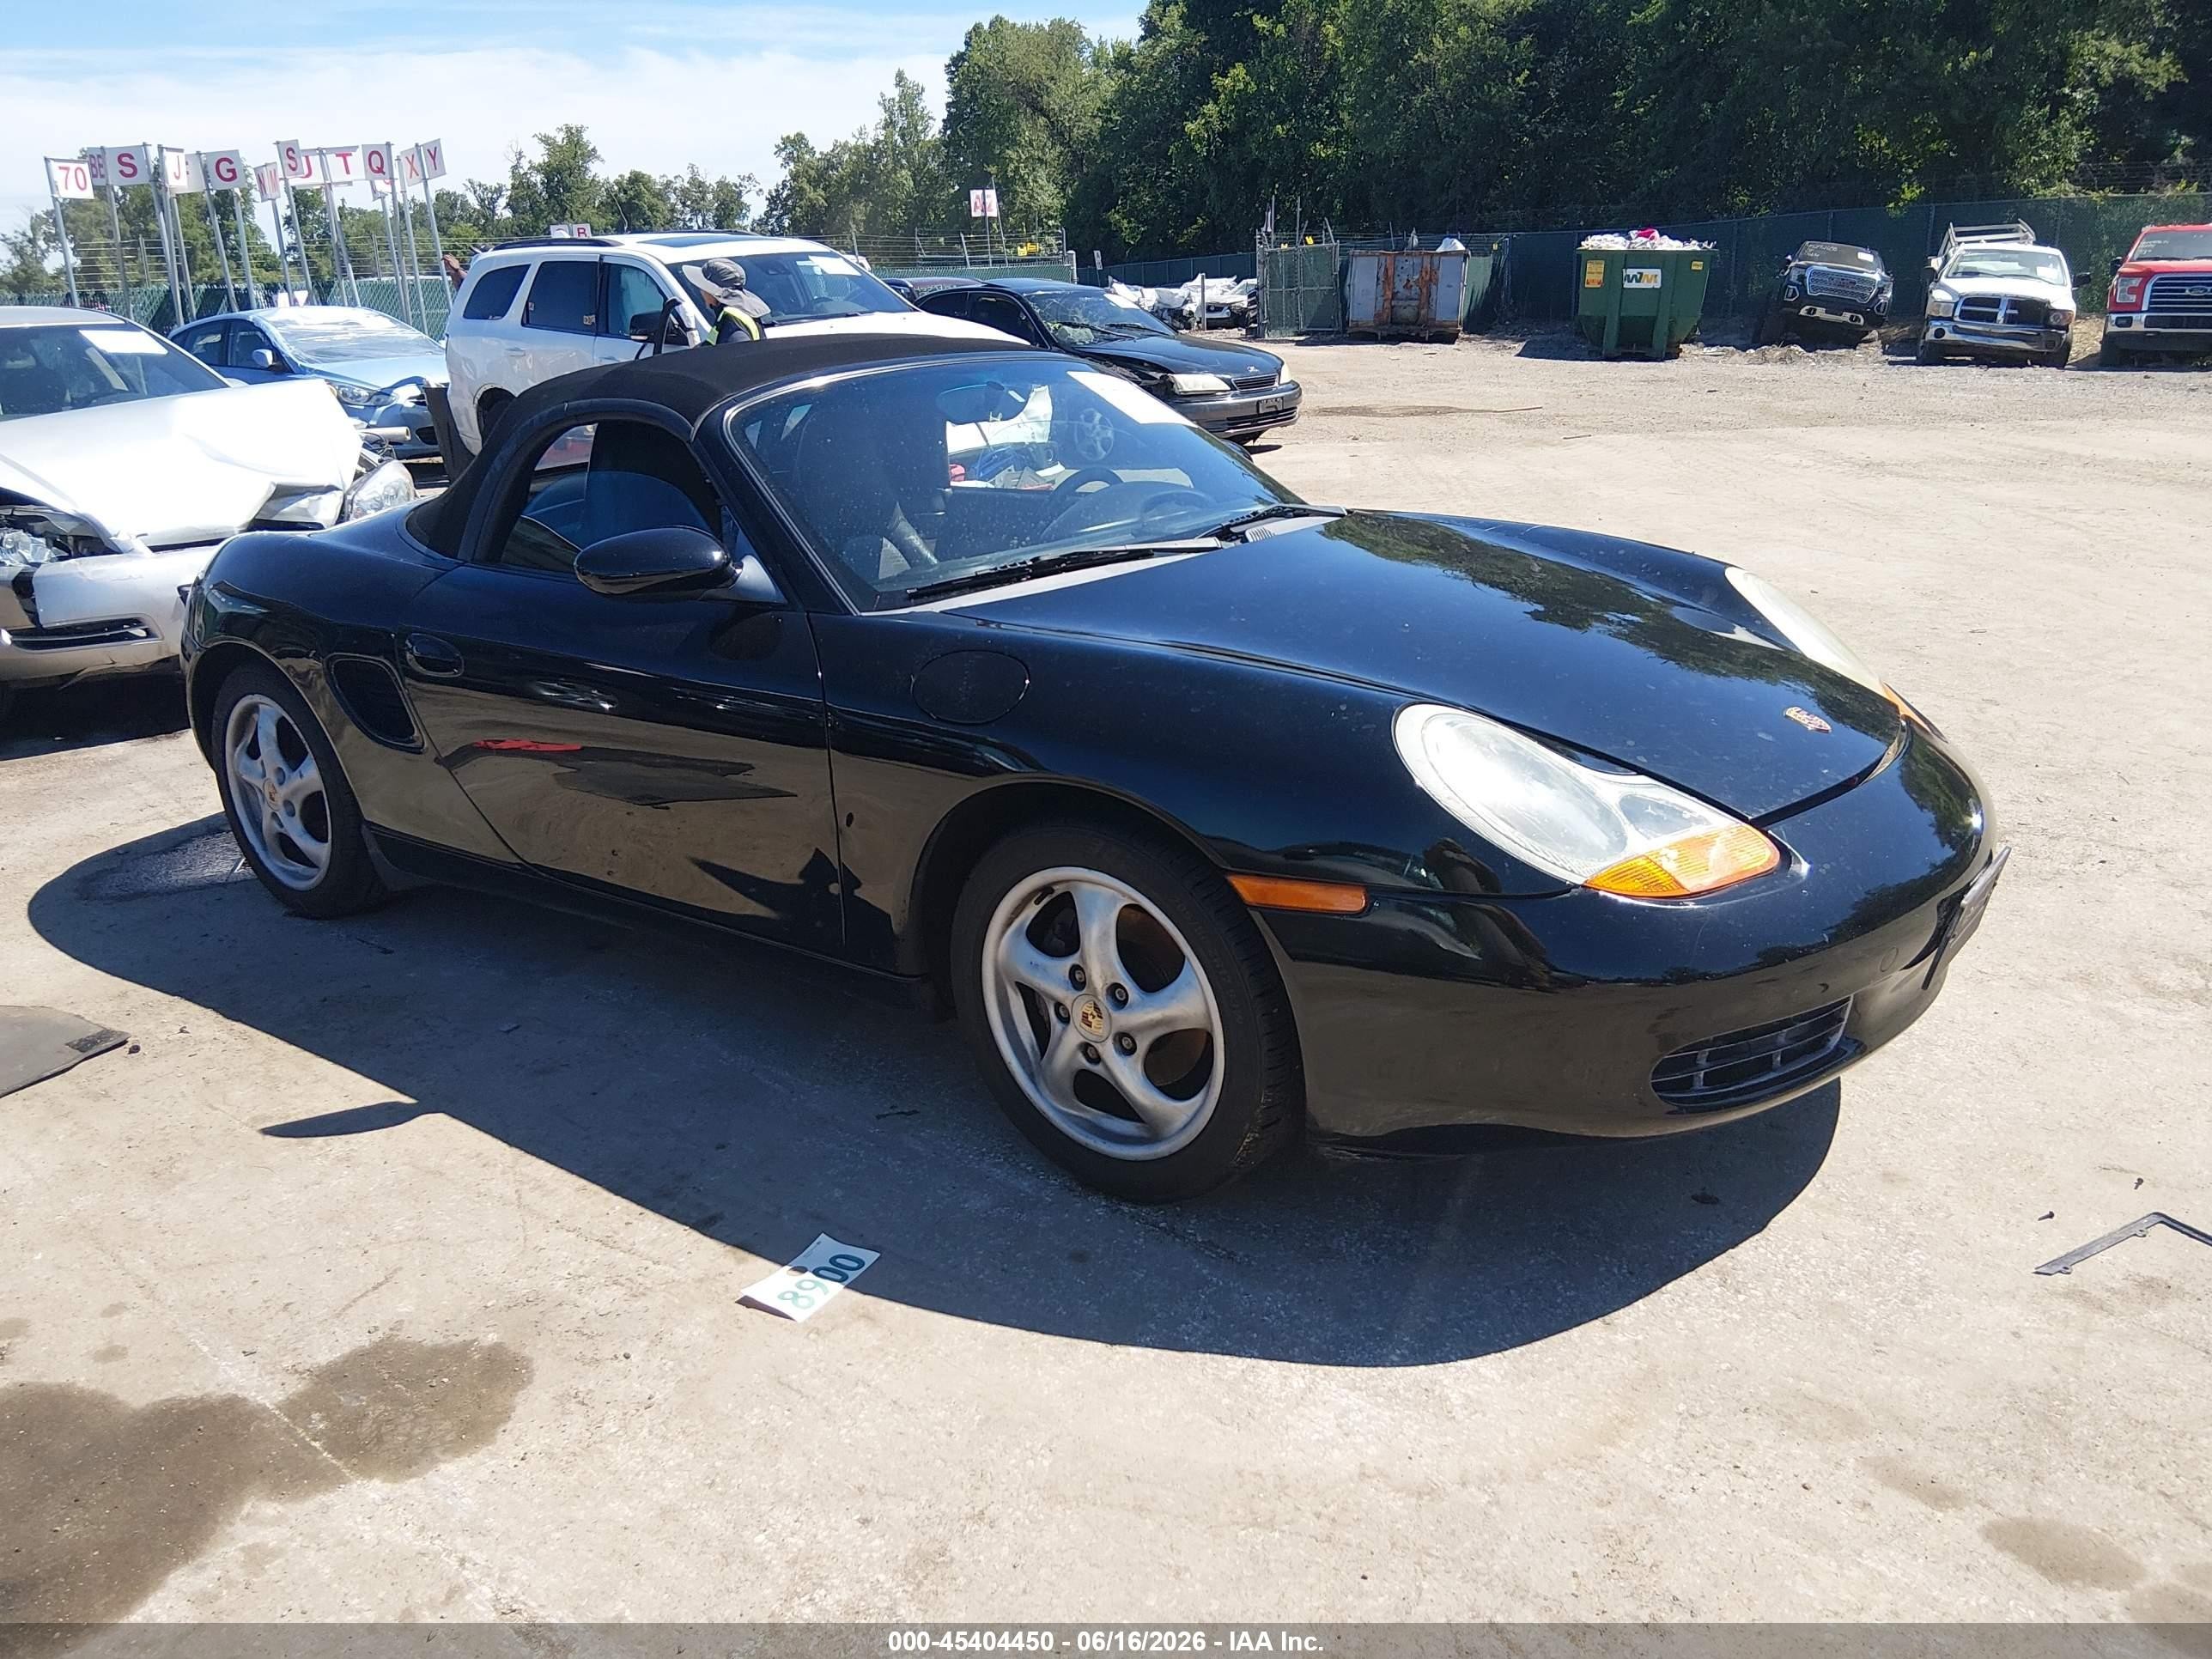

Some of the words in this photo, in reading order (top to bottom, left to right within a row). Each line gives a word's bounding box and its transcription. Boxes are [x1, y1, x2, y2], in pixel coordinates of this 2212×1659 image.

[117, 152, 138, 179] S
[173, 155, 181, 180] J
[215, 157, 238, 182] G
[285, 146, 298, 172] S
[301, 155, 313, 179] J
[335, 152, 352, 175] T
[368, 149, 386, 176] Q
[404, 154, 420, 179] X
[427, 146, 438, 171] Y
[58, 166, 88, 191] 70
[777, 1254, 866, 1310] 8900
